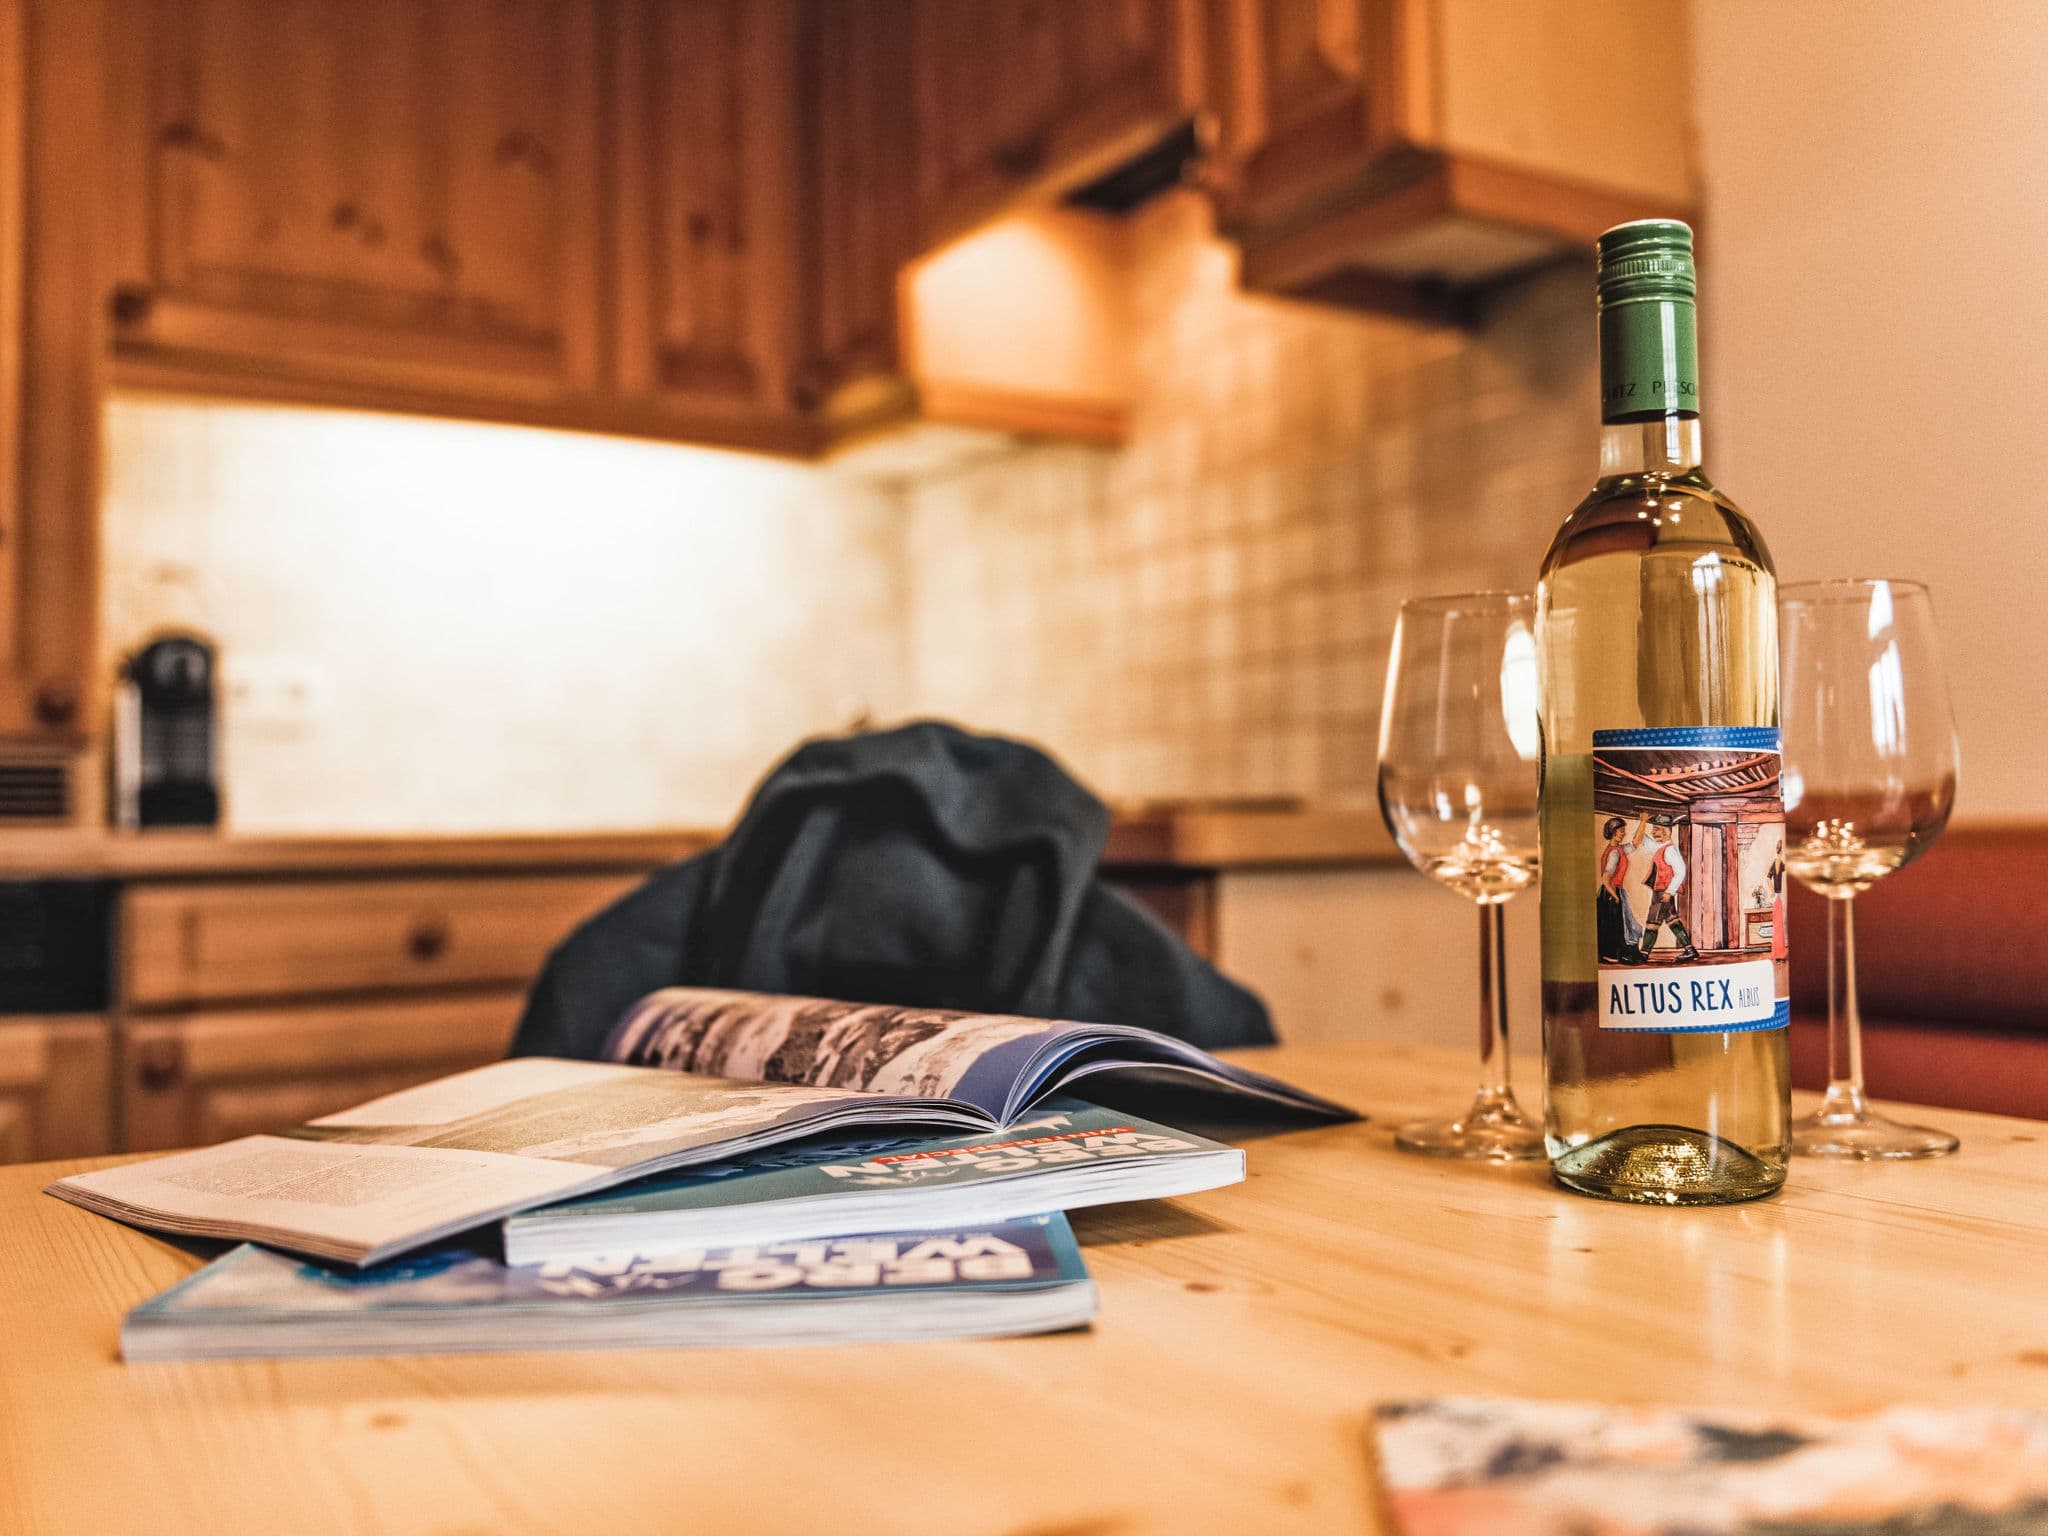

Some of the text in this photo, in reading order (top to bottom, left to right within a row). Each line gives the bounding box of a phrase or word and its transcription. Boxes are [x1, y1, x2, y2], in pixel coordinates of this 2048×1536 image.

[1610, 981, 1683, 1015] ALTUS
[1690, 978, 1734, 1012] REX
[818, 1131, 1173, 1179] WELTEN
[973, 1137, 1201, 1173] BERG
